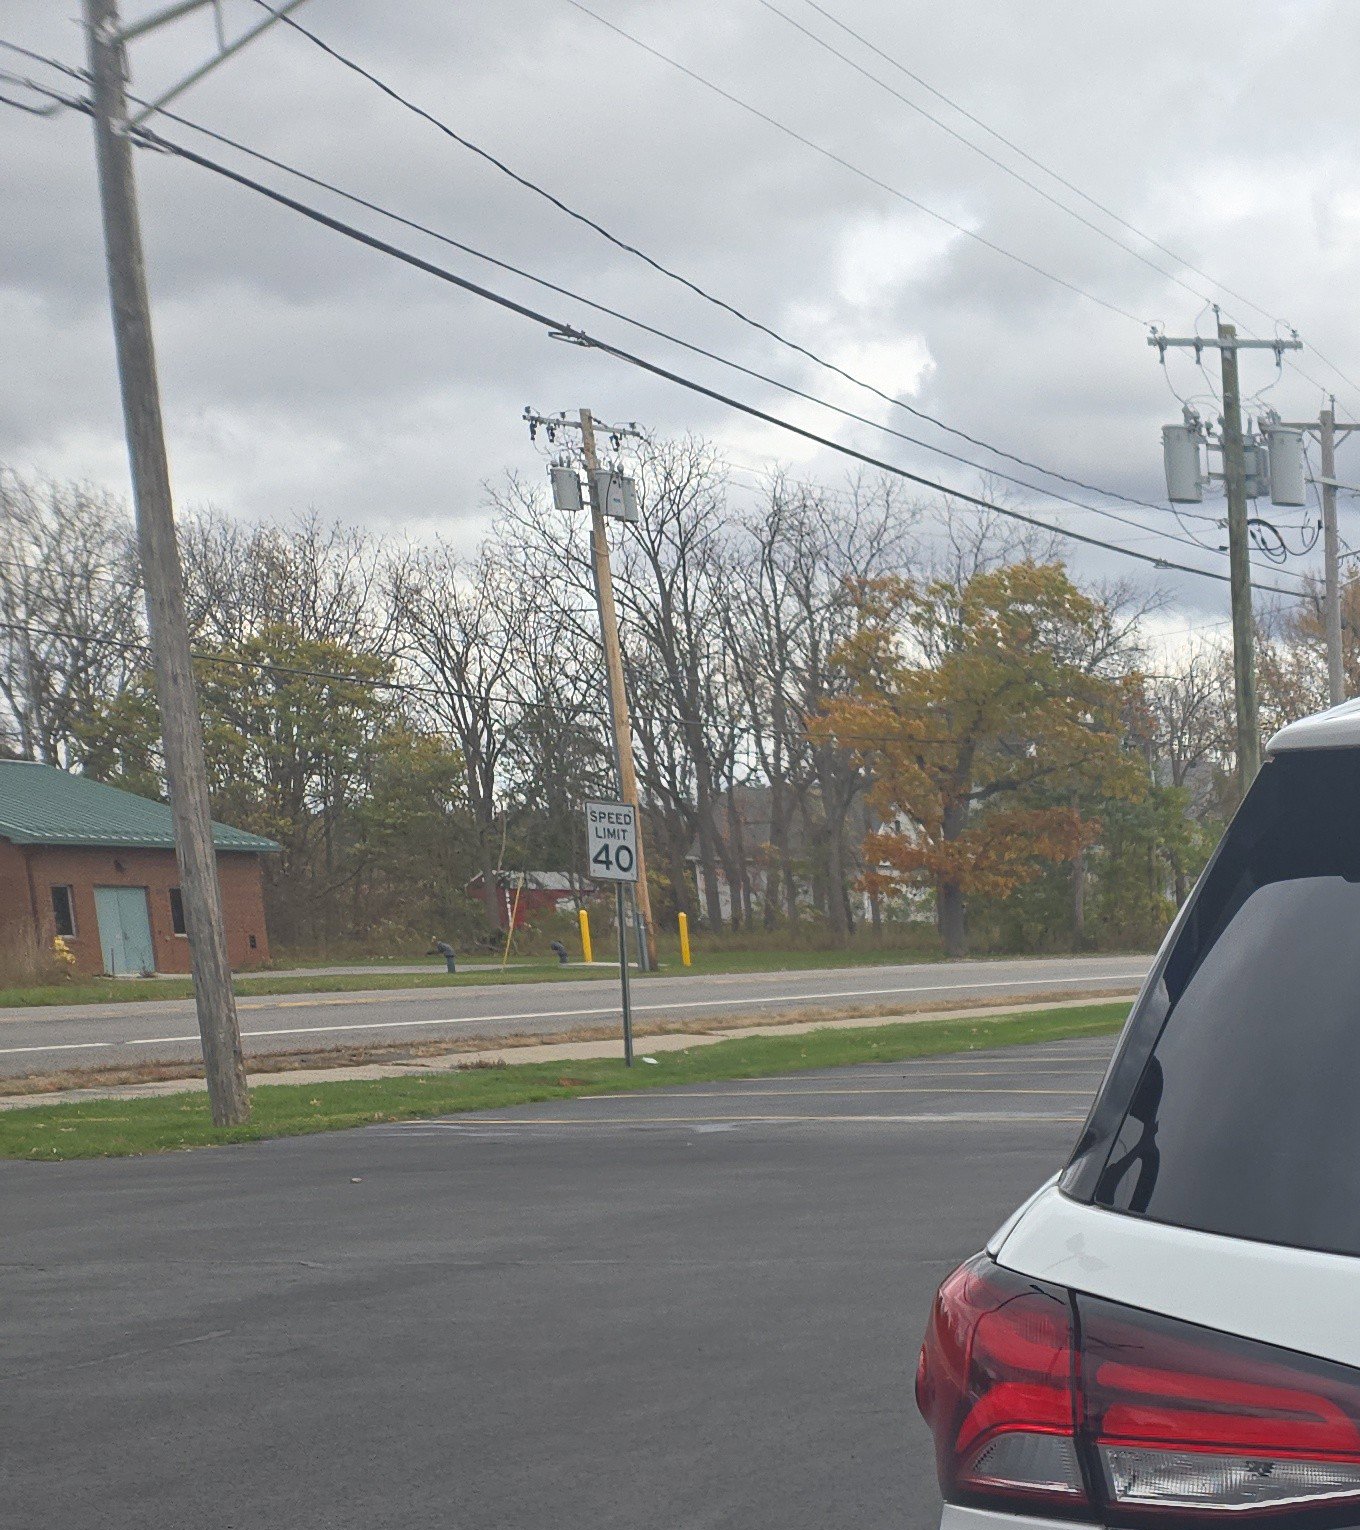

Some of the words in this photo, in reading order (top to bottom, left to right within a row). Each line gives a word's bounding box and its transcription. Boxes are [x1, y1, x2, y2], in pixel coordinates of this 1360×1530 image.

[589, 810, 633, 826] SPEED
[595, 826, 629, 841] LIMIT
[592, 843, 634, 873] 40
